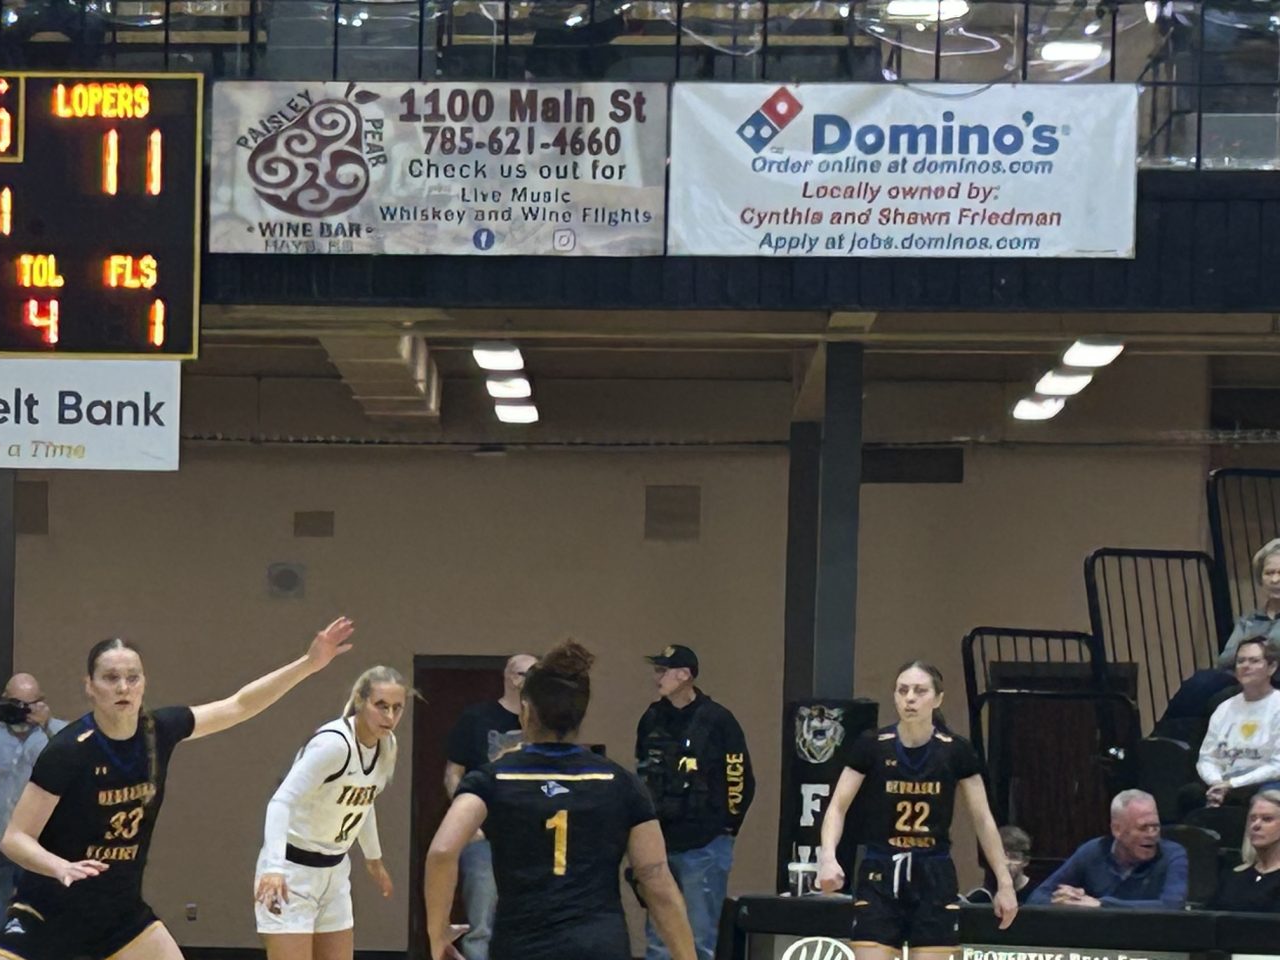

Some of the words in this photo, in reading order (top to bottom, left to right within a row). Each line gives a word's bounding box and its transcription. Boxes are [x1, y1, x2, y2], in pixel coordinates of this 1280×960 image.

[51, 82, 150, 119] LOPERS
[399, 88, 495, 123] 1100
[509, 88, 595, 123] Main
[609, 89, 646, 123] St
[236, 89, 314, 150] PAISLEY
[813, 111, 1060, 156] Domino's
[364, 118, 388, 167] PEAR
[422, 126, 622, 156] 785-621-4660
[102, 128, 162, 196] 11
[408, 159, 488, 180] Check
[500, 163, 527, 180] us
[539, 160, 578, 180] out
[592, 159, 627, 180] for
[751, 156, 813, 174] Order
[817, 156, 882, 174] online
[887, 157, 907, 174] at
[913, 156, 1053, 174] dominos.com
[460, 187, 502, 203] Live
[511, 187, 571, 204] Music
[802, 181, 881, 203] Locally
[887, 182, 961, 201] owned
[967, 182, 1001, 203] by:
[258, 222, 313, 238] WINE
[320, 222, 362, 238] BAR
[379, 206, 466, 224] Whiskey
[473, 207, 512, 222] and
[521, 207, 572, 222] Wine
[582, 207, 653, 226] Flights
[740, 206, 824, 229] Cynthia
[829, 207, 872, 225] and
[878, 207, 951, 226] Shawn
[957, 207, 1062, 226] Friedman
[758, 232, 819, 254] Apply
[825, 233, 845, 250] at
[848, 232, 1040, 254] jobs.dominos.com
[17, 254, 65, 288] TOL
[104, 254, 158, 289] FLS
[25, 298, 59, 344] 4
[149, 298, 165, 347] 1
[58, 390, 166, 427] Bank
[7, 444, 21, 458] a
[31, 441, 86, 459] Time
[895, 801, 931, 832] 22
[545, 809, 568, 876] 1
